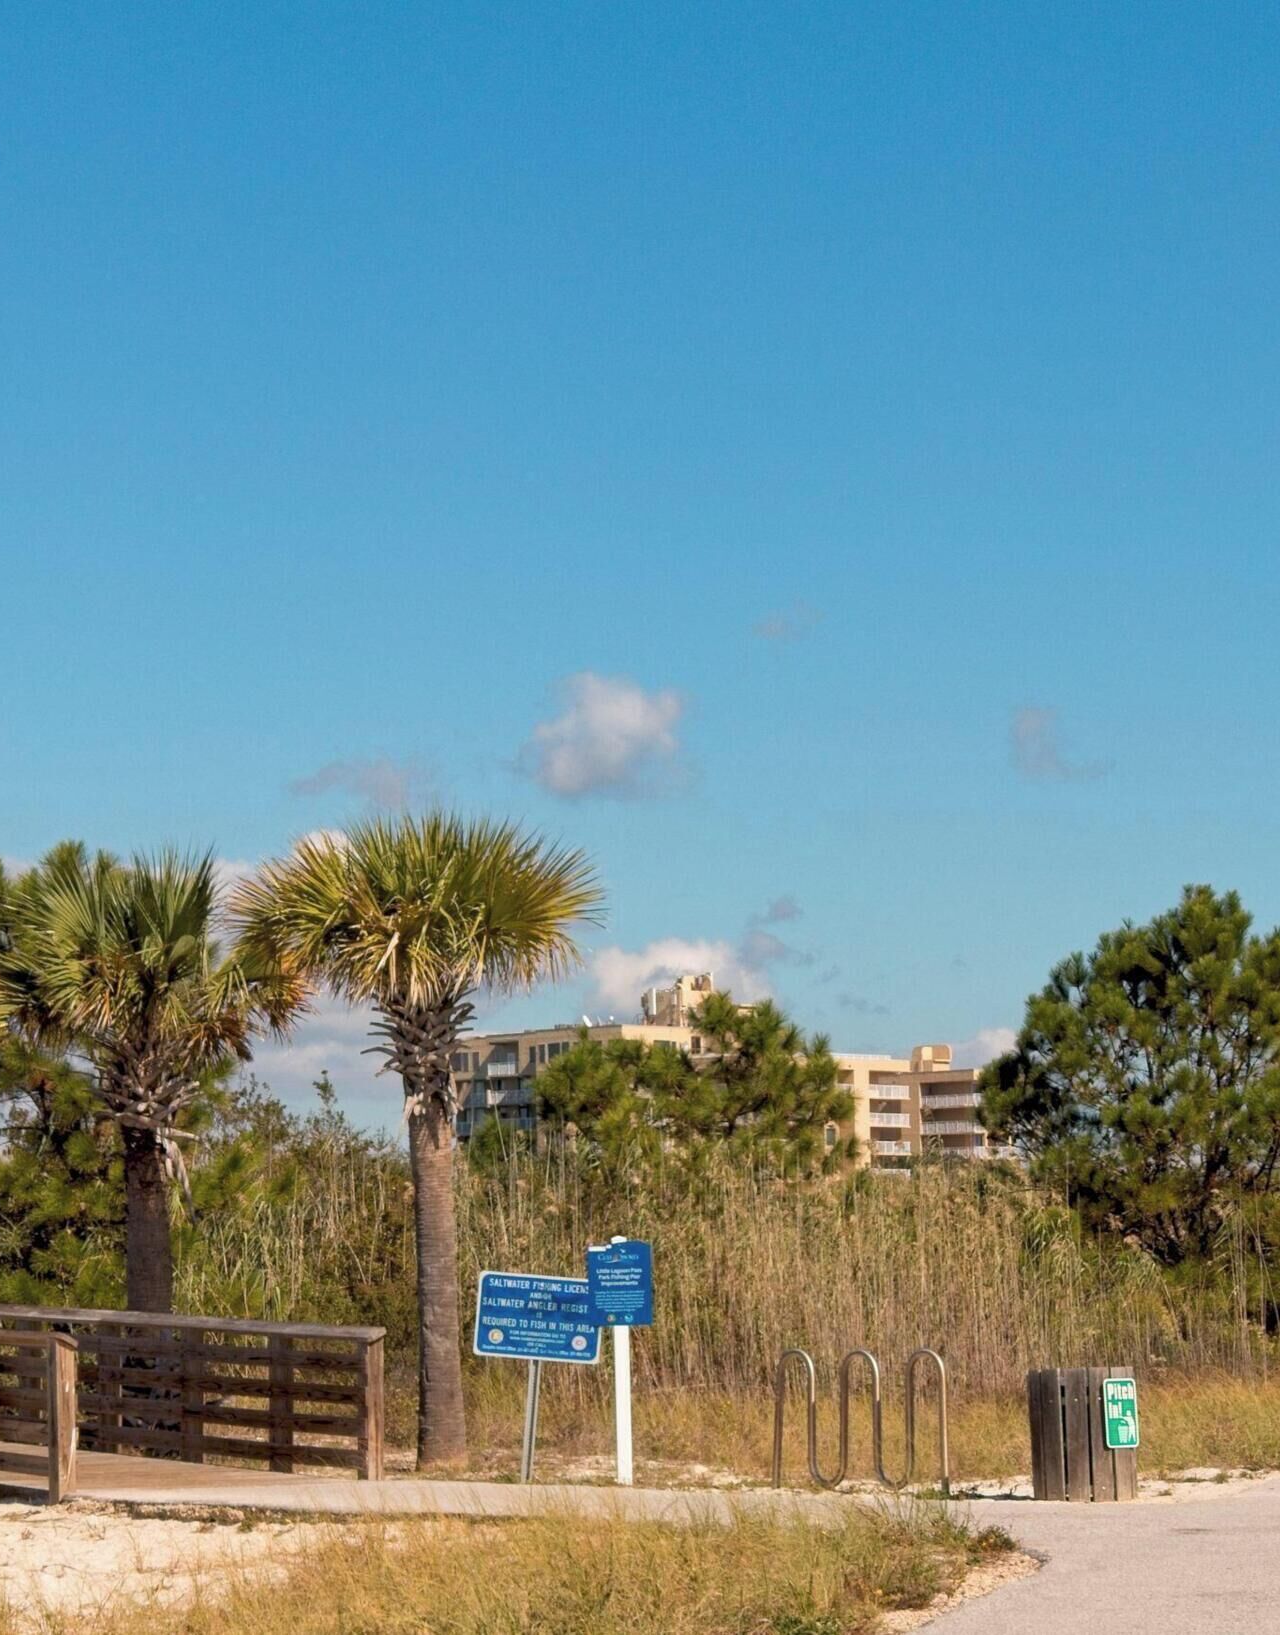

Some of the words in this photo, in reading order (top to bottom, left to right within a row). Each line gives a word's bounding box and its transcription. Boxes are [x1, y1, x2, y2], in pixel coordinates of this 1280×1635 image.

[489, 1278, 530, 1290] SALTWATER
[532, 1282, 562, 1292] FISHING
[482, 1296, 524, 1308] SALTWATER
[528, 1300, 558, 1311] ANGLER
[482, 1316, 517, 1327] REQUIRED
[520, 1319, 528, 1328] TO
[530, 1320, 547, 1330] FISH
[549, 1322, 556, 1330] IN
[560, 1322, 574, 1332] THIS
[576, 1324, 595, 1334] AREA
[1106, 1382, 1134, 1400] Pitch
[1108, 1401, 1122, 1418] In!
